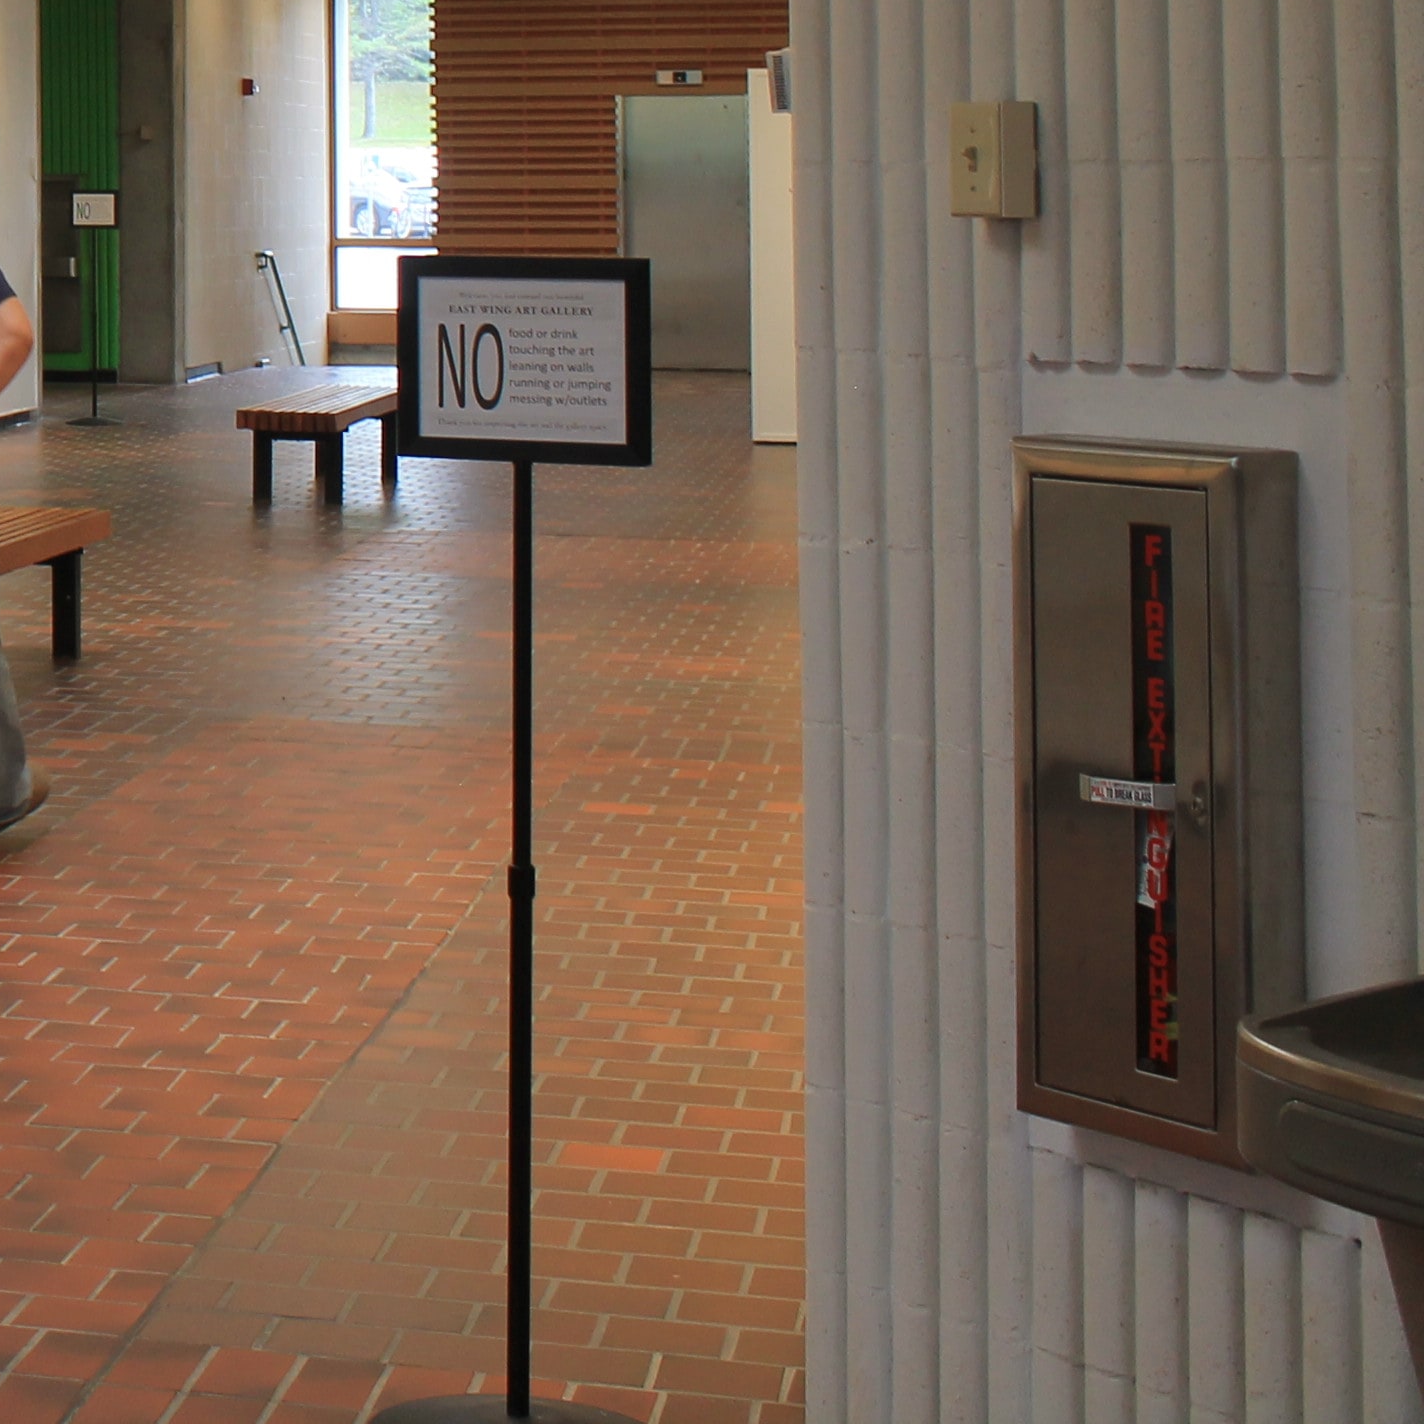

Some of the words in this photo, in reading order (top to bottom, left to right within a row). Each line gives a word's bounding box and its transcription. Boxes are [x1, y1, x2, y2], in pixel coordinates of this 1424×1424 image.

[76, 202, 91, 219] NO
[449, 305, 476, 314] EAST
[480, 305, 512, 315] WING
[515, 306, 537, 315] ART
[540, 307, 594, 317] GALLERY
[508, 328, 533, 338] food
[550, 328, 578, 339] drink
[509, 345, 555, 357] touching
[558, 345, 576, 355] the
[578, 347, 594, 356] art
[438, 323, 504, 411] NO
[509, 362, 548, 374] leaning
[567, 363, 594, 372] walls
[509, 379, 550, 390] running
[568, 379, 611, 392] jumping
[509, 395, 553, 407] messing
[555, 395, 608, 407] w/outlets
[1145, 535, 1165, 661] FIRE
[1091, 786, 1105, 797] PULL
[1115, 788, 1133, 800] BREAK
[1134, 790, 1152, 803] GLASS
